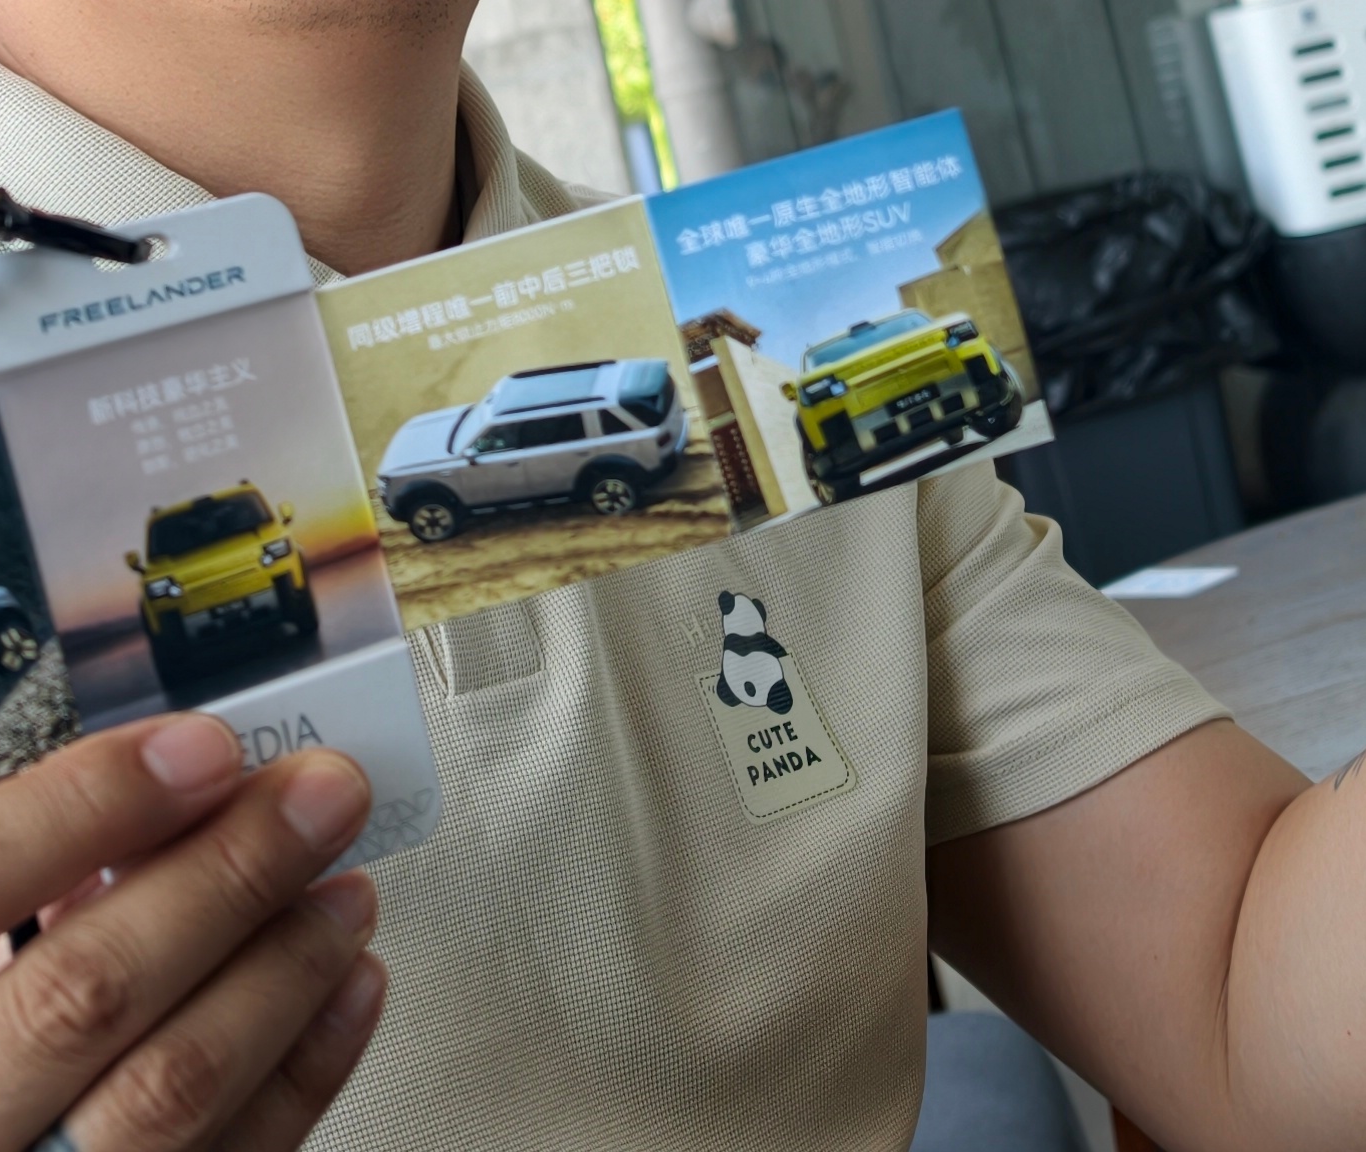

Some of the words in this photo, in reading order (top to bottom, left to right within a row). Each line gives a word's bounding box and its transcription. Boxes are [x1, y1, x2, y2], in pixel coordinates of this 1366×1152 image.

[746, 202, 912, 269] 豪华全地形SUV
[40, 265, 247, 333] FREELANDER
[237, 713, 324, 774] DIA
[746, 746, 822, 787] PANDA
[747, 721, 799, 753] CUTE
